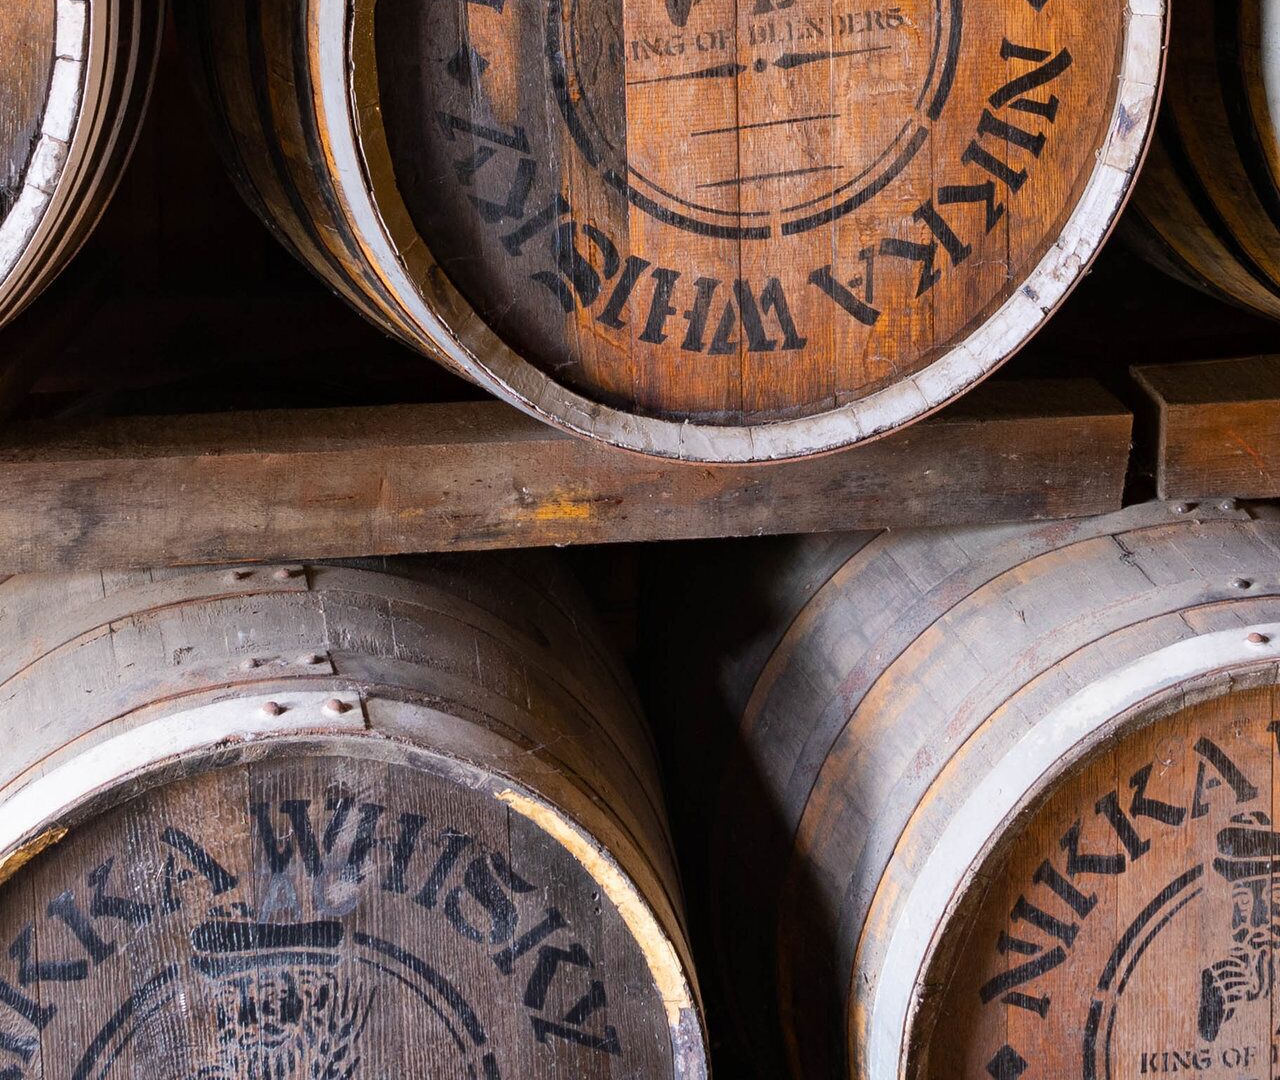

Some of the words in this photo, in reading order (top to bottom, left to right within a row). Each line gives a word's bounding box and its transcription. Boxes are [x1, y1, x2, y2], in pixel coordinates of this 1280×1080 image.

[748, 6, 904, 46] BLENDERS
[438, 107, 808, 356] WHISKY
[809, 37, 1074, 327] NIKKA
[250, 798, 622, 1058] WHISKY
[979, 736, 1260, 1020] NIKKA
[1140, 1048, 1212, 1074] KING
[1220, 1045, 1257, 1068] OF
